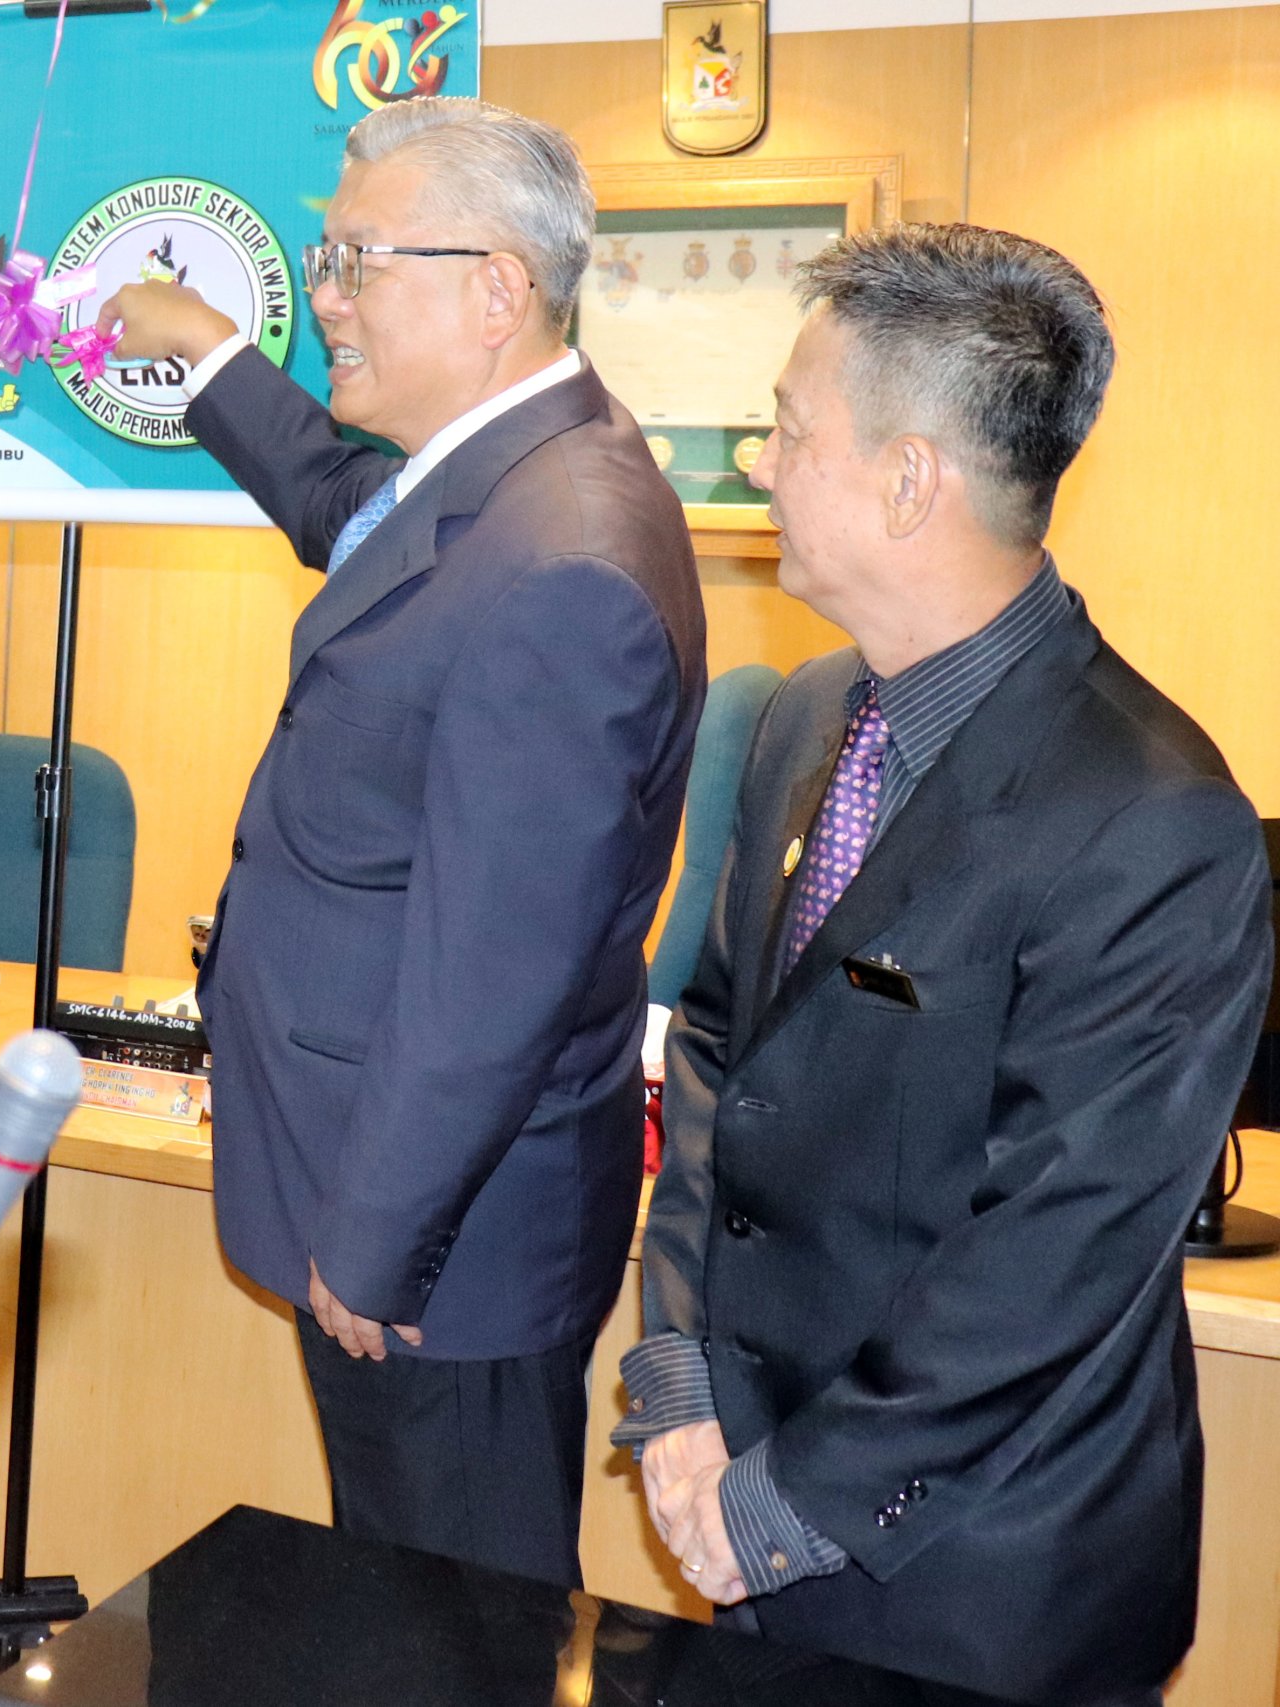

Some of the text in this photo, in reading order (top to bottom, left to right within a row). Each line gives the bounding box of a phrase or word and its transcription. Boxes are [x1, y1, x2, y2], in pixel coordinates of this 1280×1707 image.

[105, 183, 202, 224] KONDUSIF
[205, 192, 269, 256] SEKTOR
[258, 256, 287, 319] AWAM
[66, 371, 119, 424] MAJLIS
